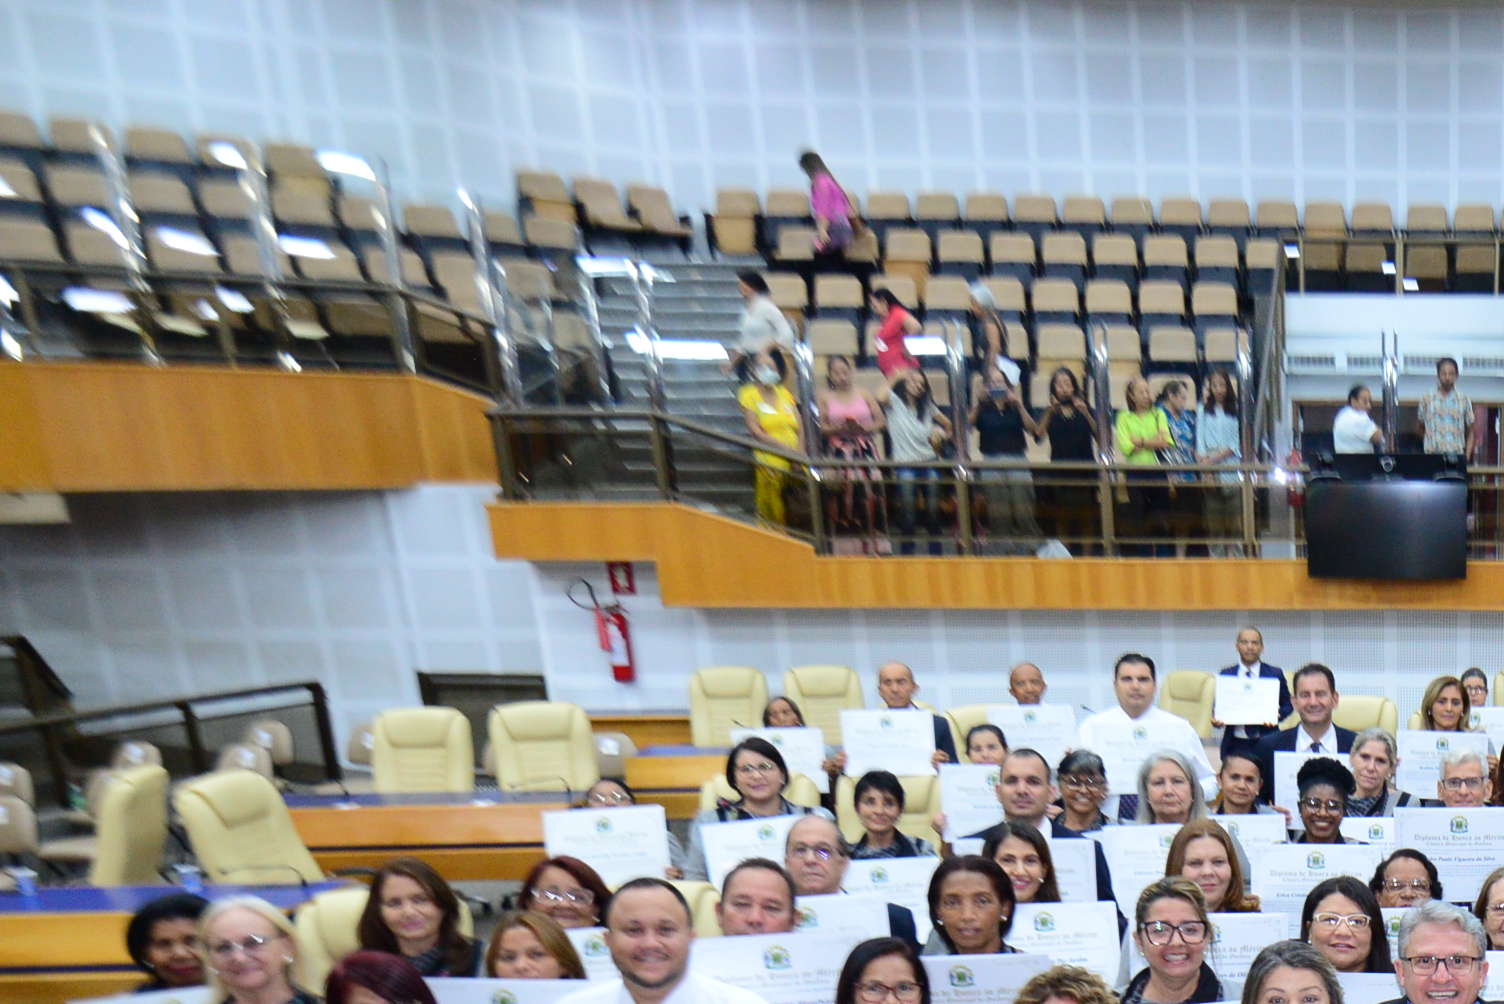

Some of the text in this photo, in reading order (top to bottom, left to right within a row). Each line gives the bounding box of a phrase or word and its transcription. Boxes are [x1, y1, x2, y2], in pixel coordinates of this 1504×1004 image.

[1413, 834, 1441, 842] Diploma
[1442, 834, 1449, 842] de
[1451, 834, 1472, 842] Honra
